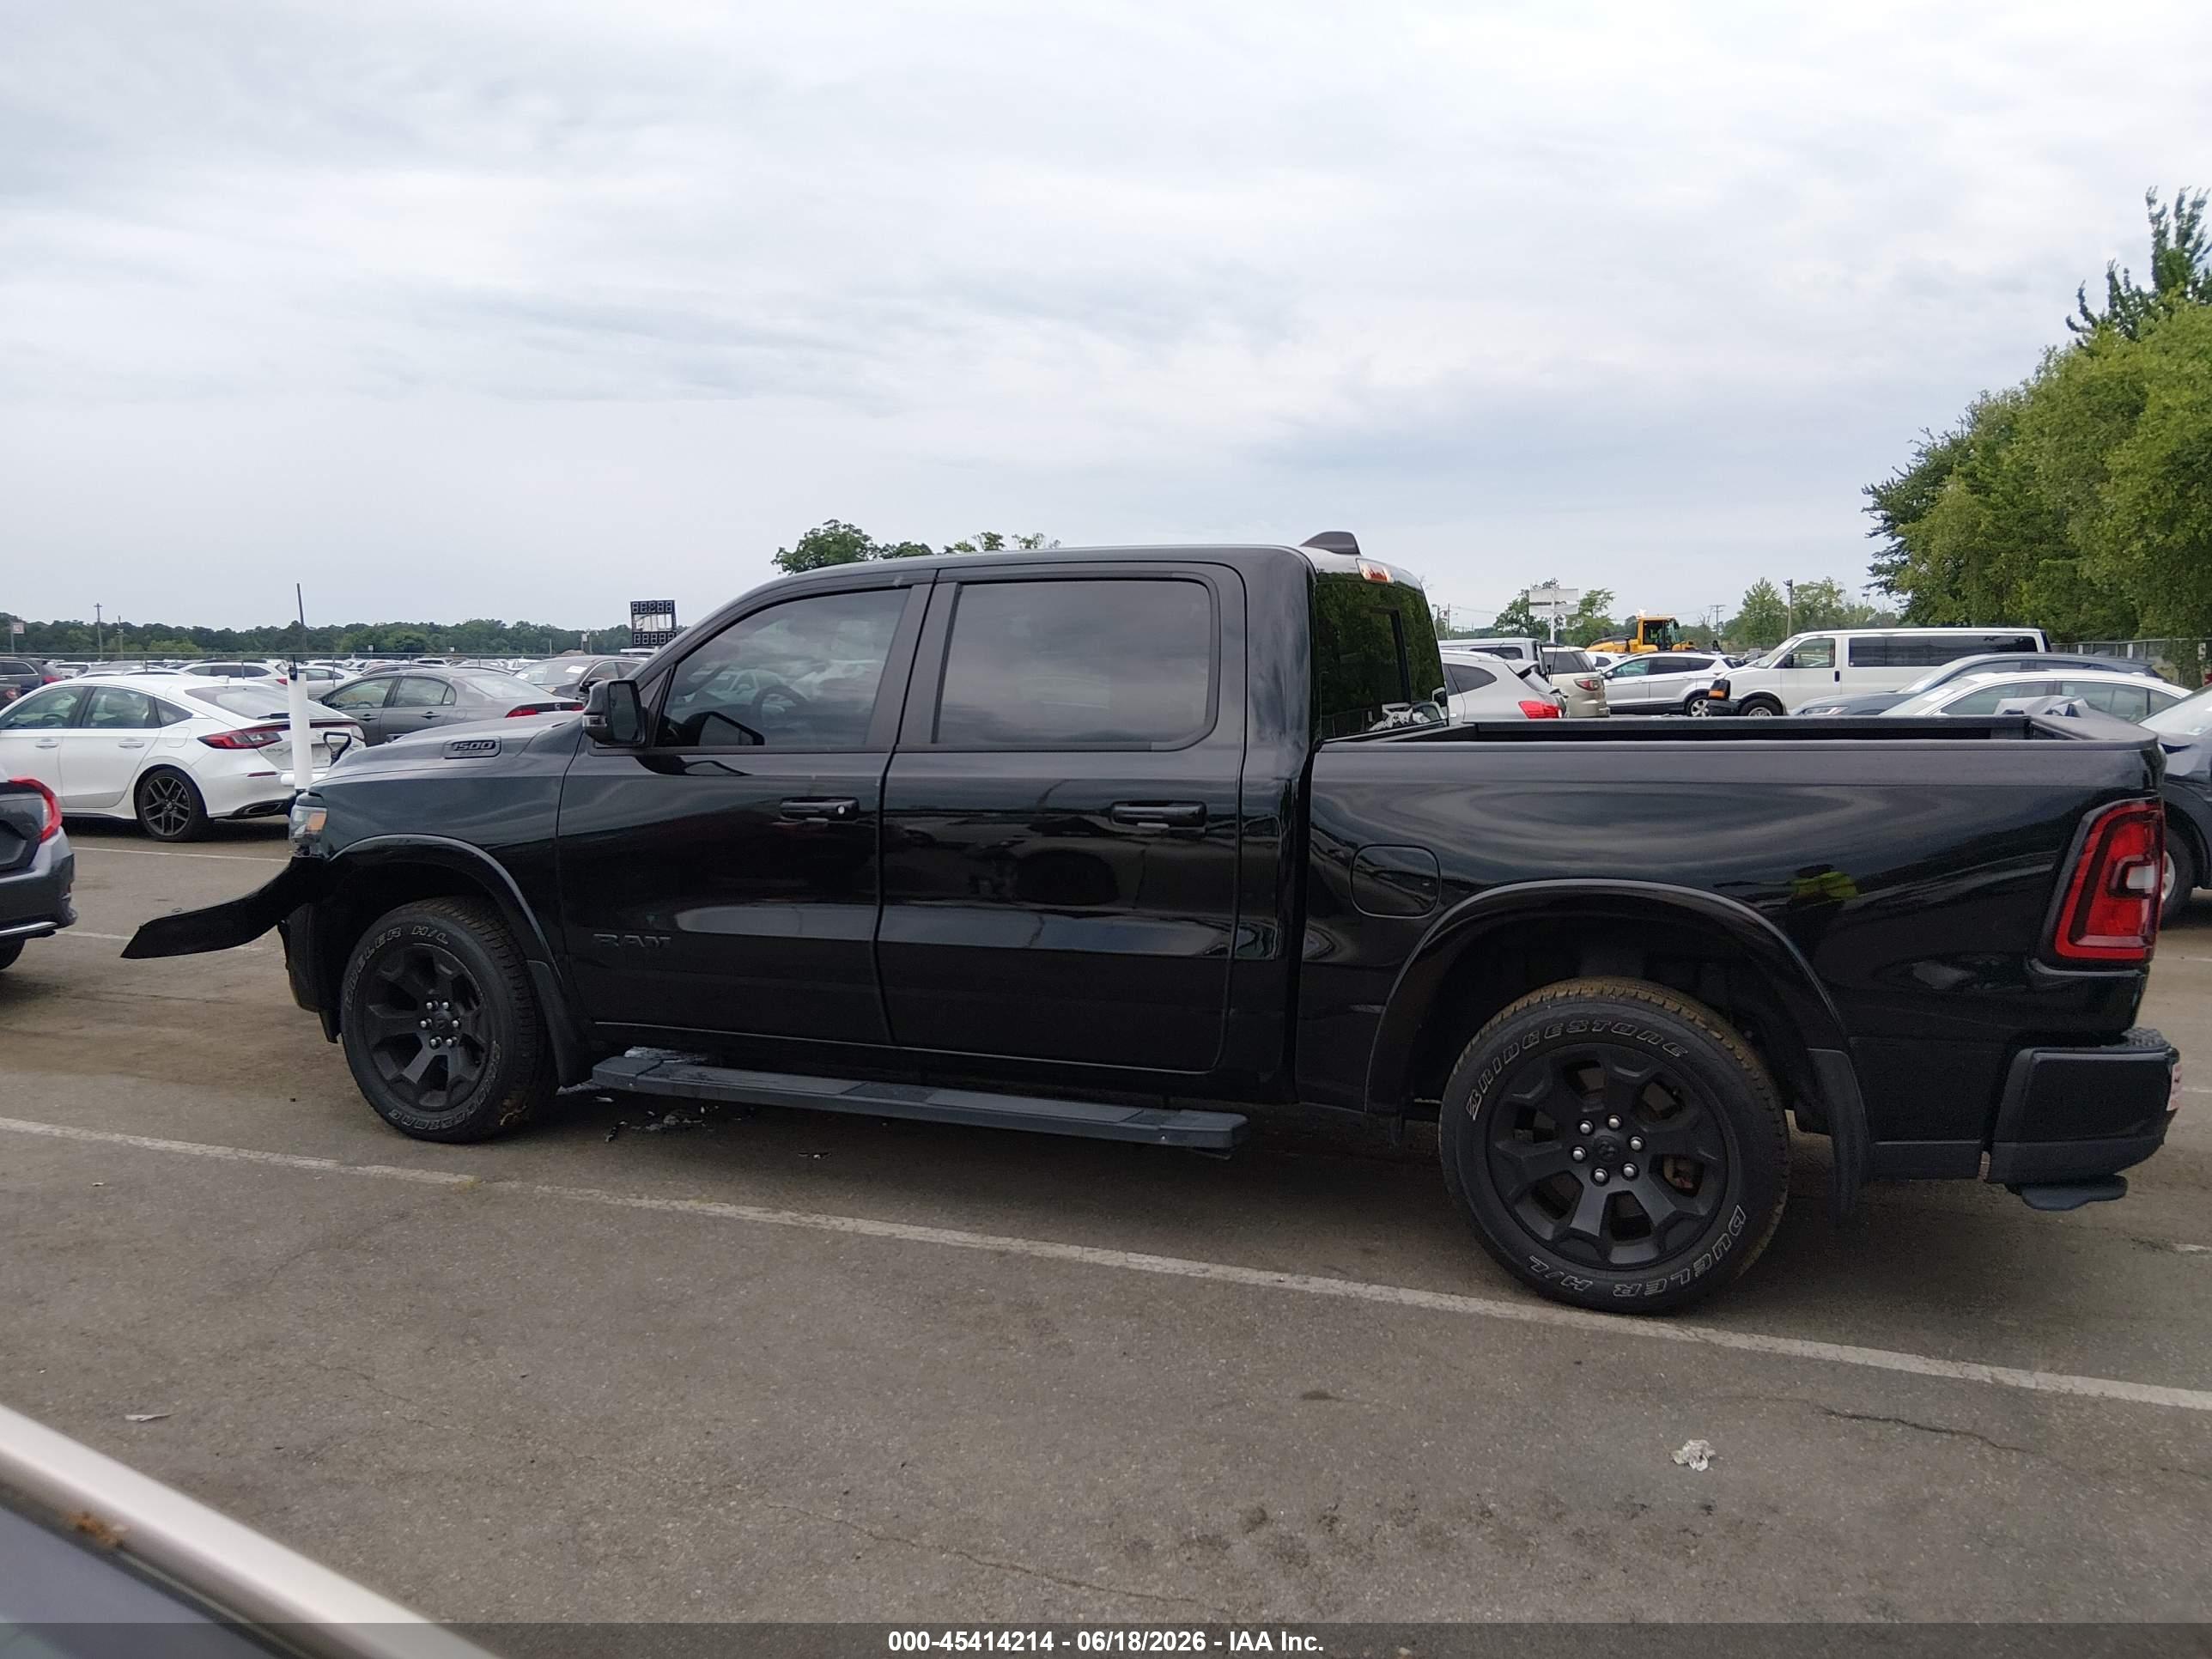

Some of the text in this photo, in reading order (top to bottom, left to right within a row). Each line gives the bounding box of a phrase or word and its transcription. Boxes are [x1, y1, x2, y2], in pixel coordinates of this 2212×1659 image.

[453, 740, 495, 751] 1500
[412, 927, 450, 945] H/L
[592, 933, 672, 949] RAM
[1466, 1019, 1689, 1121] BRIDGESTONE
[1528, 1205, 1747, 1297] DUELER H/L
